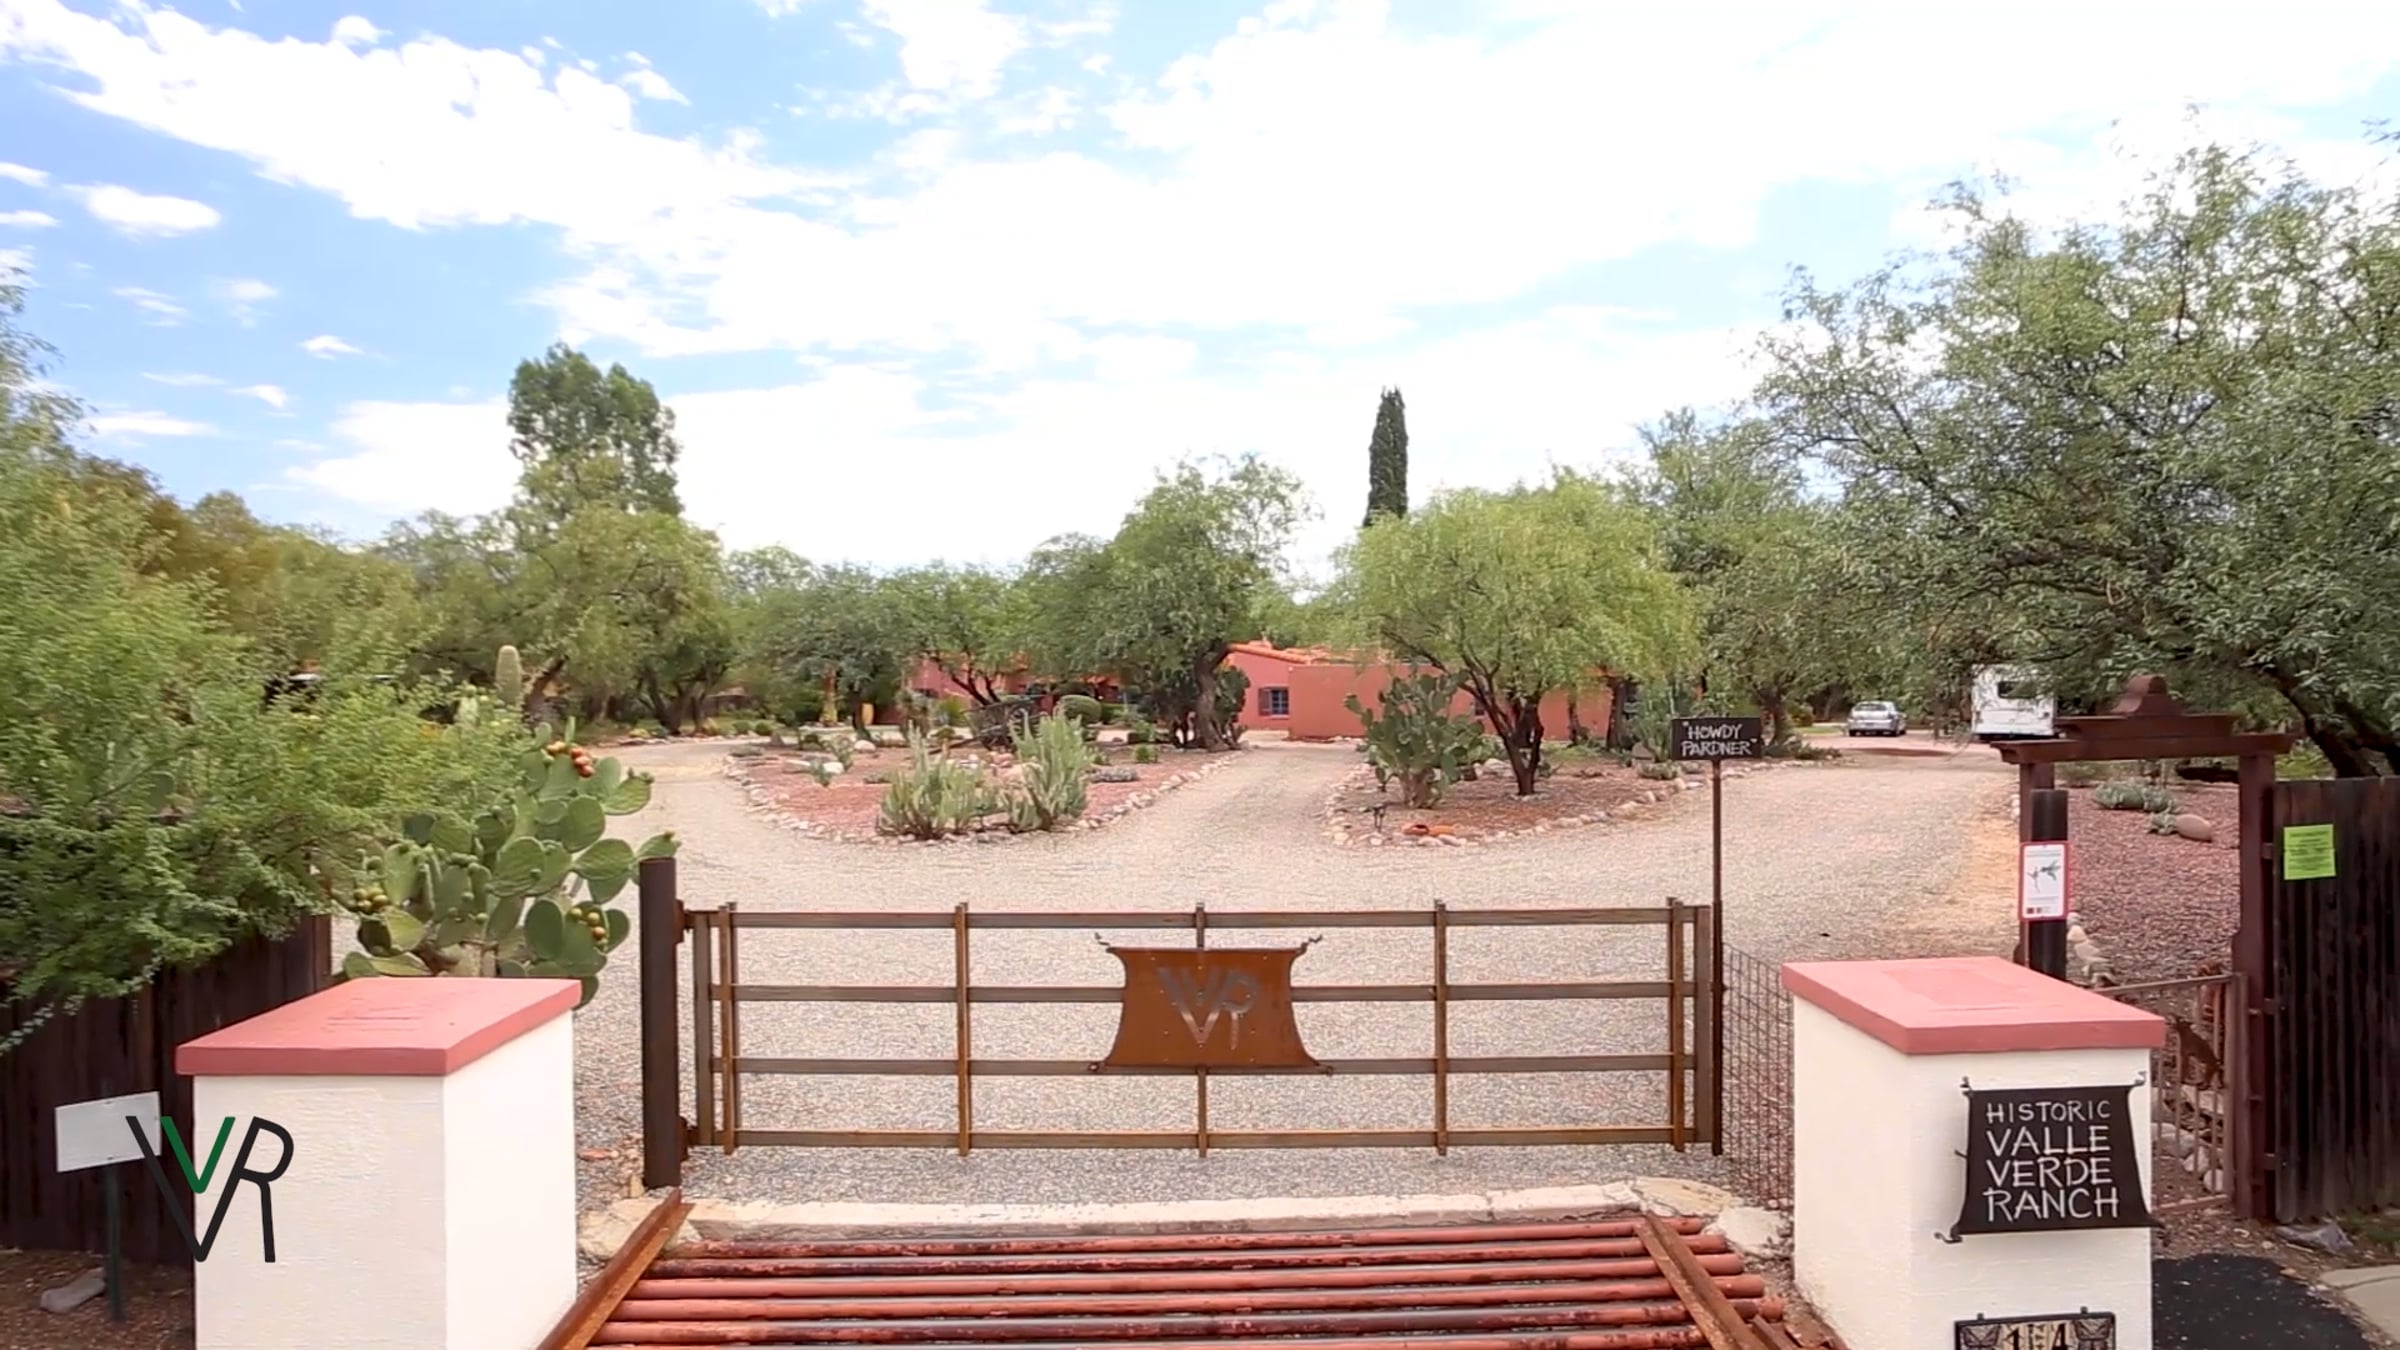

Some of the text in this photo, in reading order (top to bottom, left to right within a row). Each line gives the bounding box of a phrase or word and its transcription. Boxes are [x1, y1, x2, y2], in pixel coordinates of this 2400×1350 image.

[1986, 1099, 2111, 1124] HISTORIC
[1985, 1125, 2111, 1157] VALLE
[1986, 1156, 2113, 1188] VERDE
[1983, 1186, 2119, 1222] RANCH
